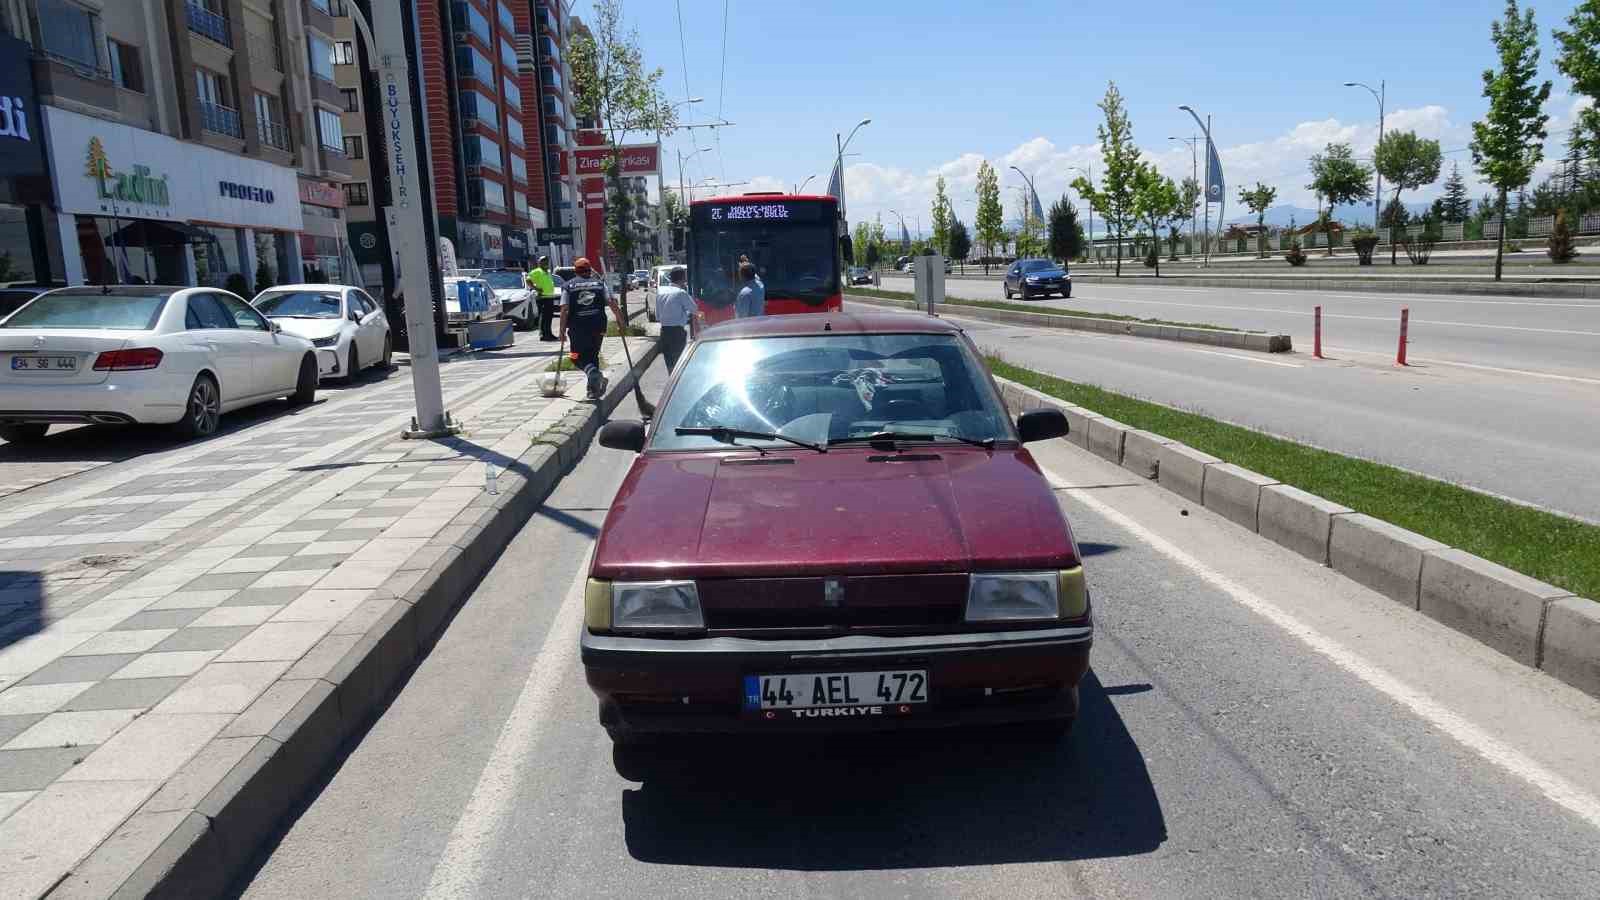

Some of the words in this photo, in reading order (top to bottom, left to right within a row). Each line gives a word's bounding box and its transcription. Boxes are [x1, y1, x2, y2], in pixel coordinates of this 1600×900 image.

[762, 678, 794, 706] 44
[811, 675, 860, 705] AEL
[876, 673, 926, 703] 472
